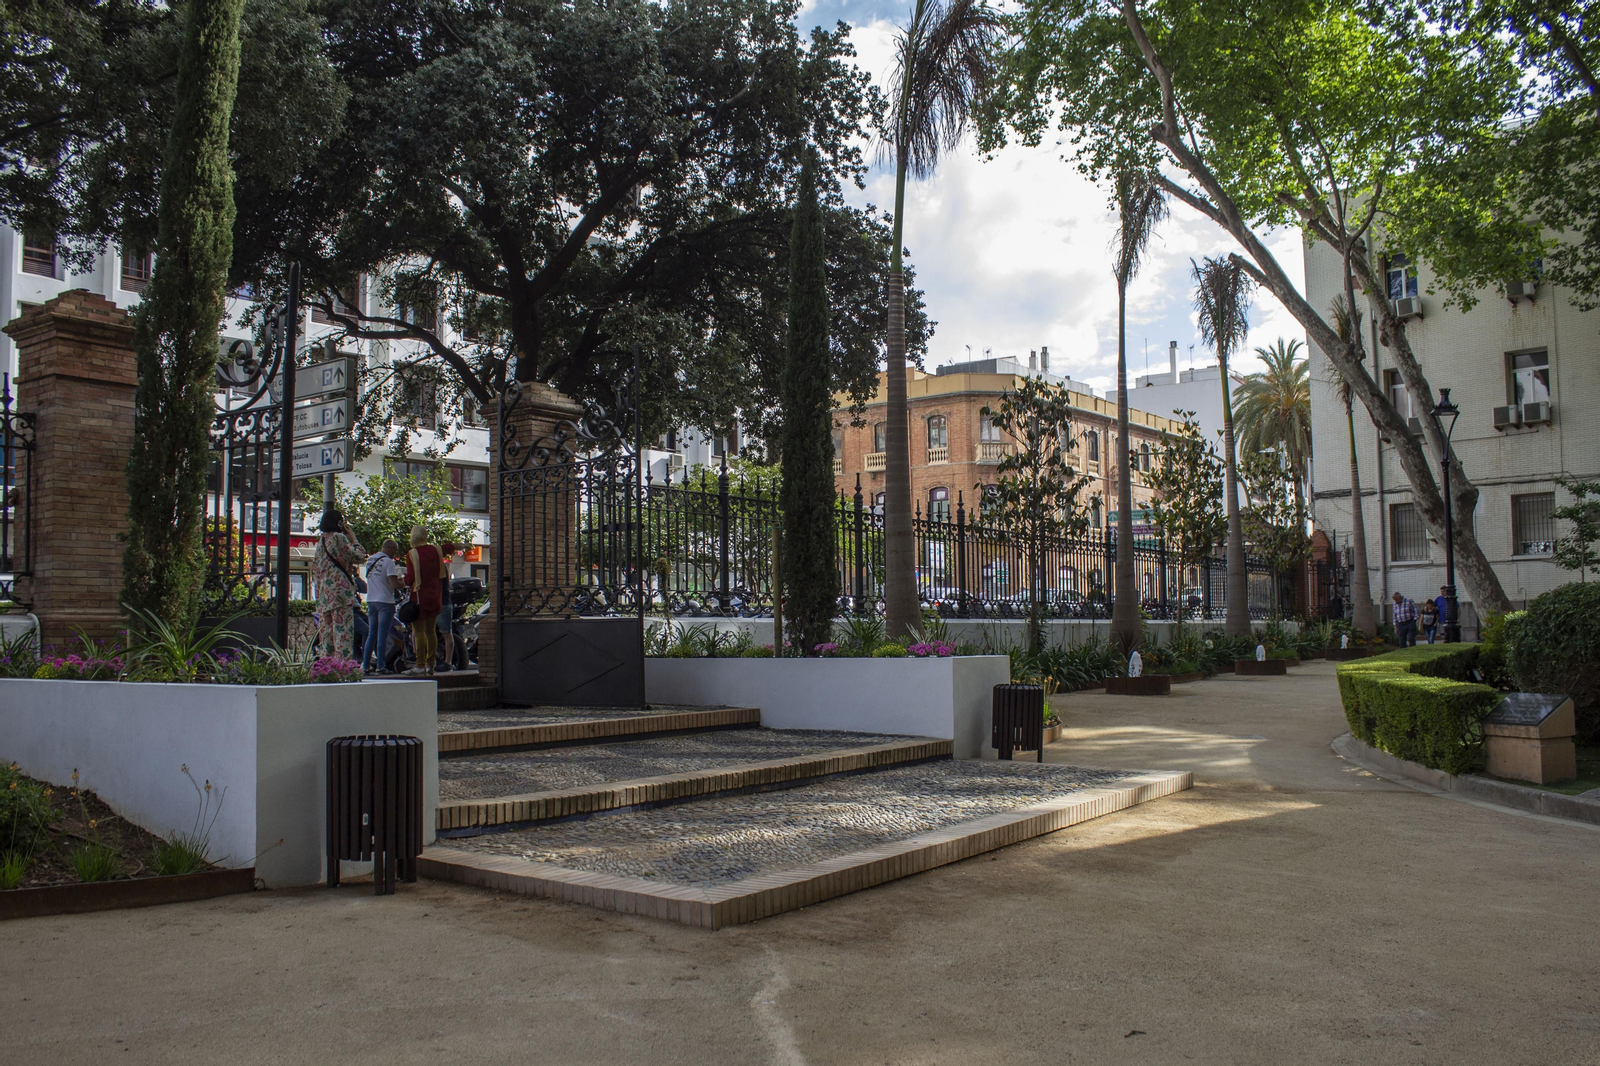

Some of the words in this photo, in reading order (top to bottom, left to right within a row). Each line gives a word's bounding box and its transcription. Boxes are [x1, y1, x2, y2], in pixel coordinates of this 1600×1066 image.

[324, 370, 331, 385] P
[324, 409, 331, 424] P
[324, 450, 331, 465] P
[296, 462, 312, 470] Tolosa
